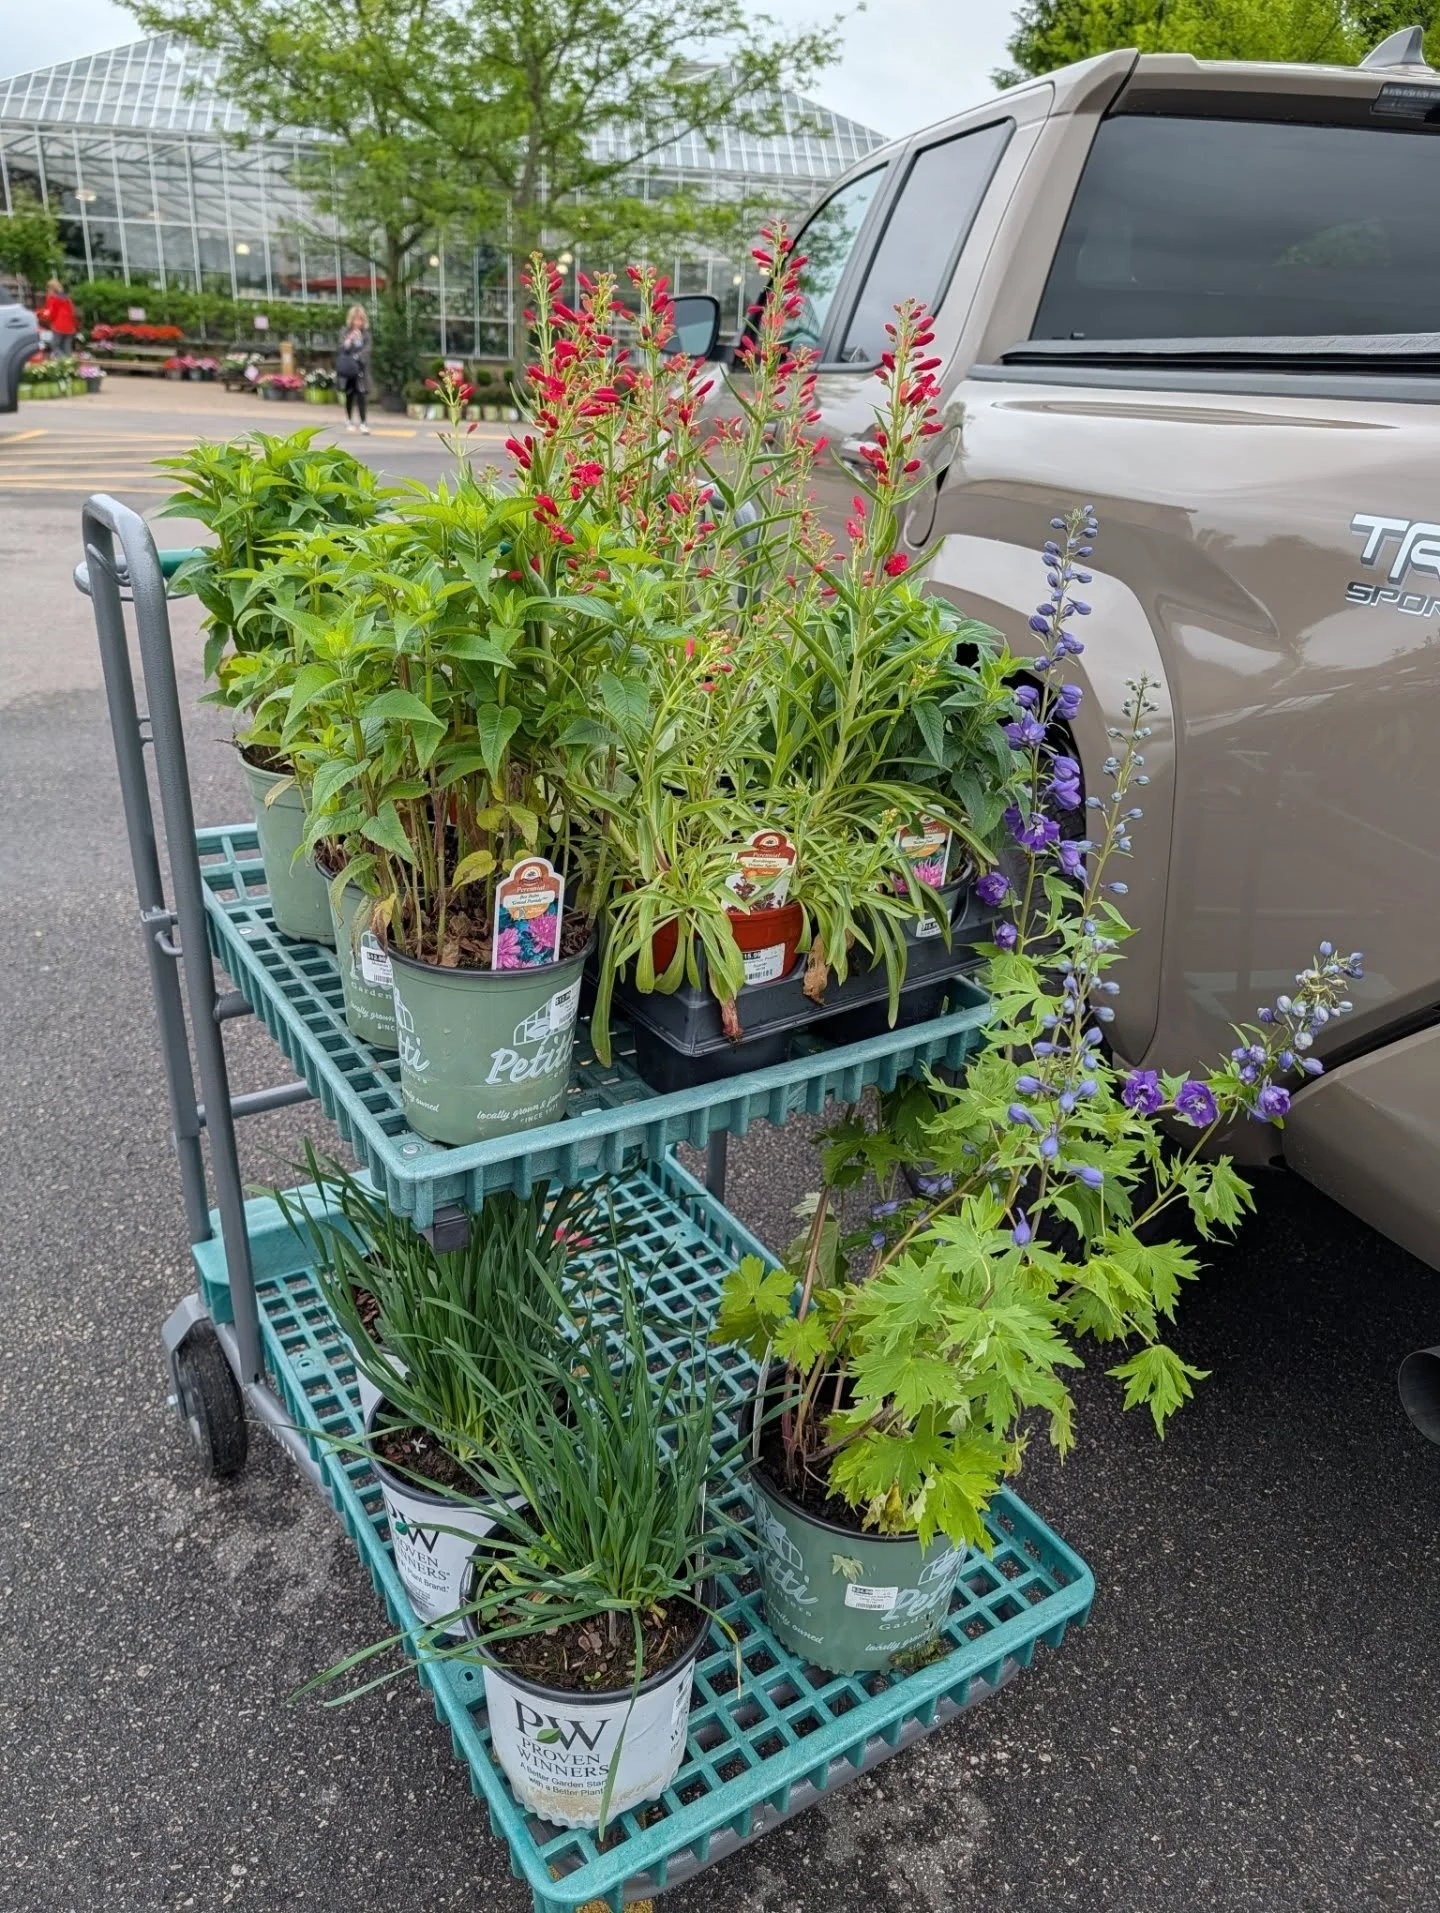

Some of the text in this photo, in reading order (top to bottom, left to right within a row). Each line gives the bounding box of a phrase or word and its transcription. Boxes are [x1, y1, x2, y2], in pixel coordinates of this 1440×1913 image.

[377, 1023, 396, 1032] SINC
[476, 1109, 510, 1121] locally
[511, 1103, 540, 1120] grown
[792, 1624, 825, 1645] owned
[511, 1695, 612, 1752] PW
[516, 1744, 609, 1778] WINNERS
[521, 1737, 601, 1766] PROVEN
[527, 1766, 549, 1782] Better
[551, 1777, 584, 1788] Garden
[529, 1776, 543, 1789] with
[553, 1786, 578, 1796] Better
[581, 1788, 604, 1797] Plant
